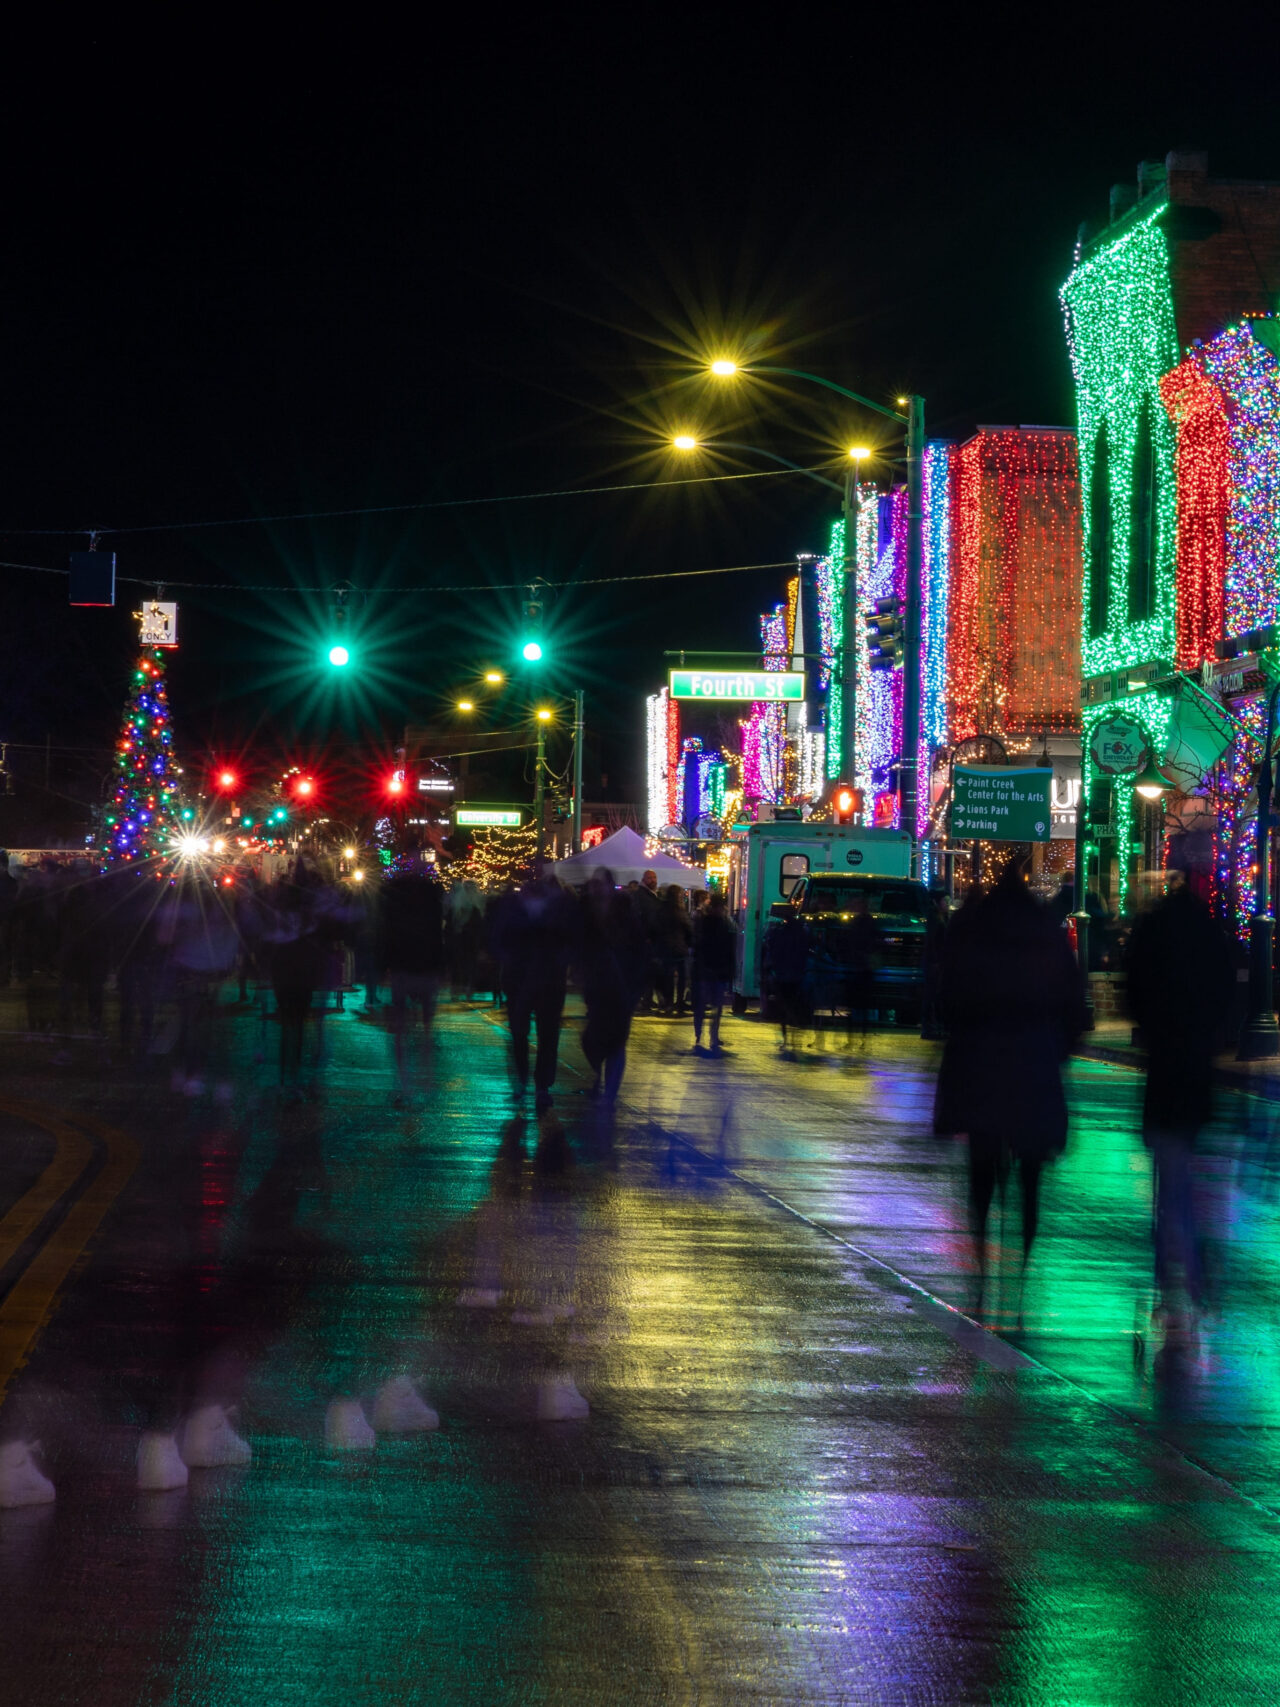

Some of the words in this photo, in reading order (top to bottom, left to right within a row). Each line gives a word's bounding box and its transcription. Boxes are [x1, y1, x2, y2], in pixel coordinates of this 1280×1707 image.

[690, 675, 755, 697] Fourth
[764, 676, 785, 697] St
[968, 778, 989, 788] Paint
[992, 779, 1015, 789] Creek
[967, 789, 994, 800] Center
[997, 790, 1008, 800] for
[1011, 792, 1025, 801] the
[1027, 792, 1044, 802] Arts
[967, 804, 988, 815] Lions
[991, 805, 1009, 815] Park
[966, 819, 998, 832] Parking
